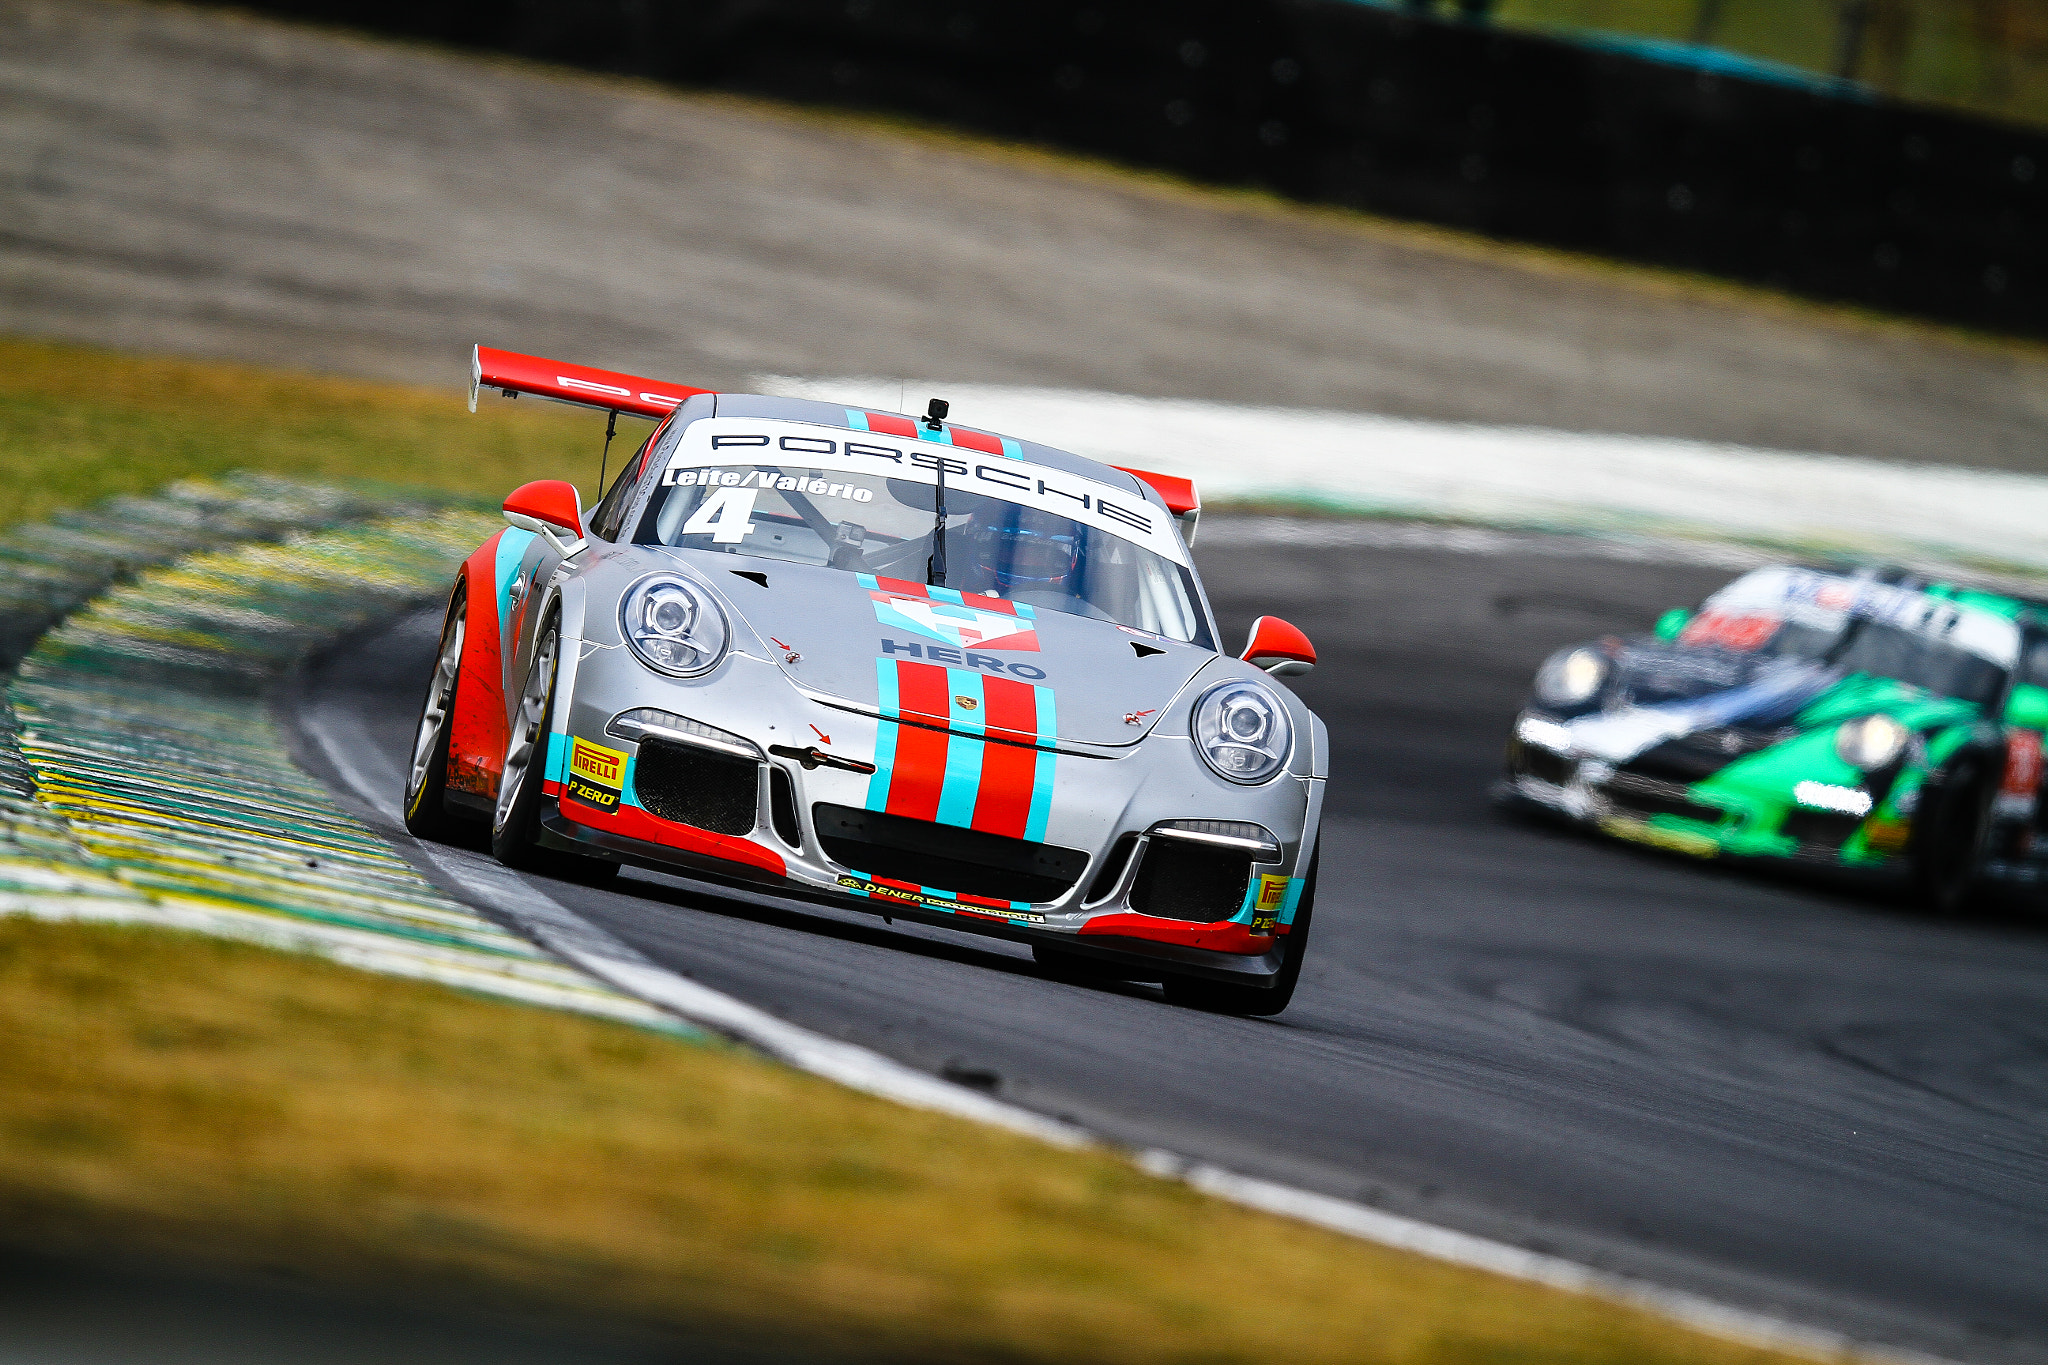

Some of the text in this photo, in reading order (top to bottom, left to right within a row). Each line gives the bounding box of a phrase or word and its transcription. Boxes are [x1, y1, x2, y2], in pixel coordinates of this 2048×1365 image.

[661, 469, 874, 503] Leite/Valério
[711, 434, 1152, 535] PORSCHE
[682, 486, 759, 544] 4
[881, 638, 1047, 680] HERO
[574, 743, 619, 780] PIRELLI
[568, 780, 615, 806] P ZERO
[863, 883, 925, 903] DENER
